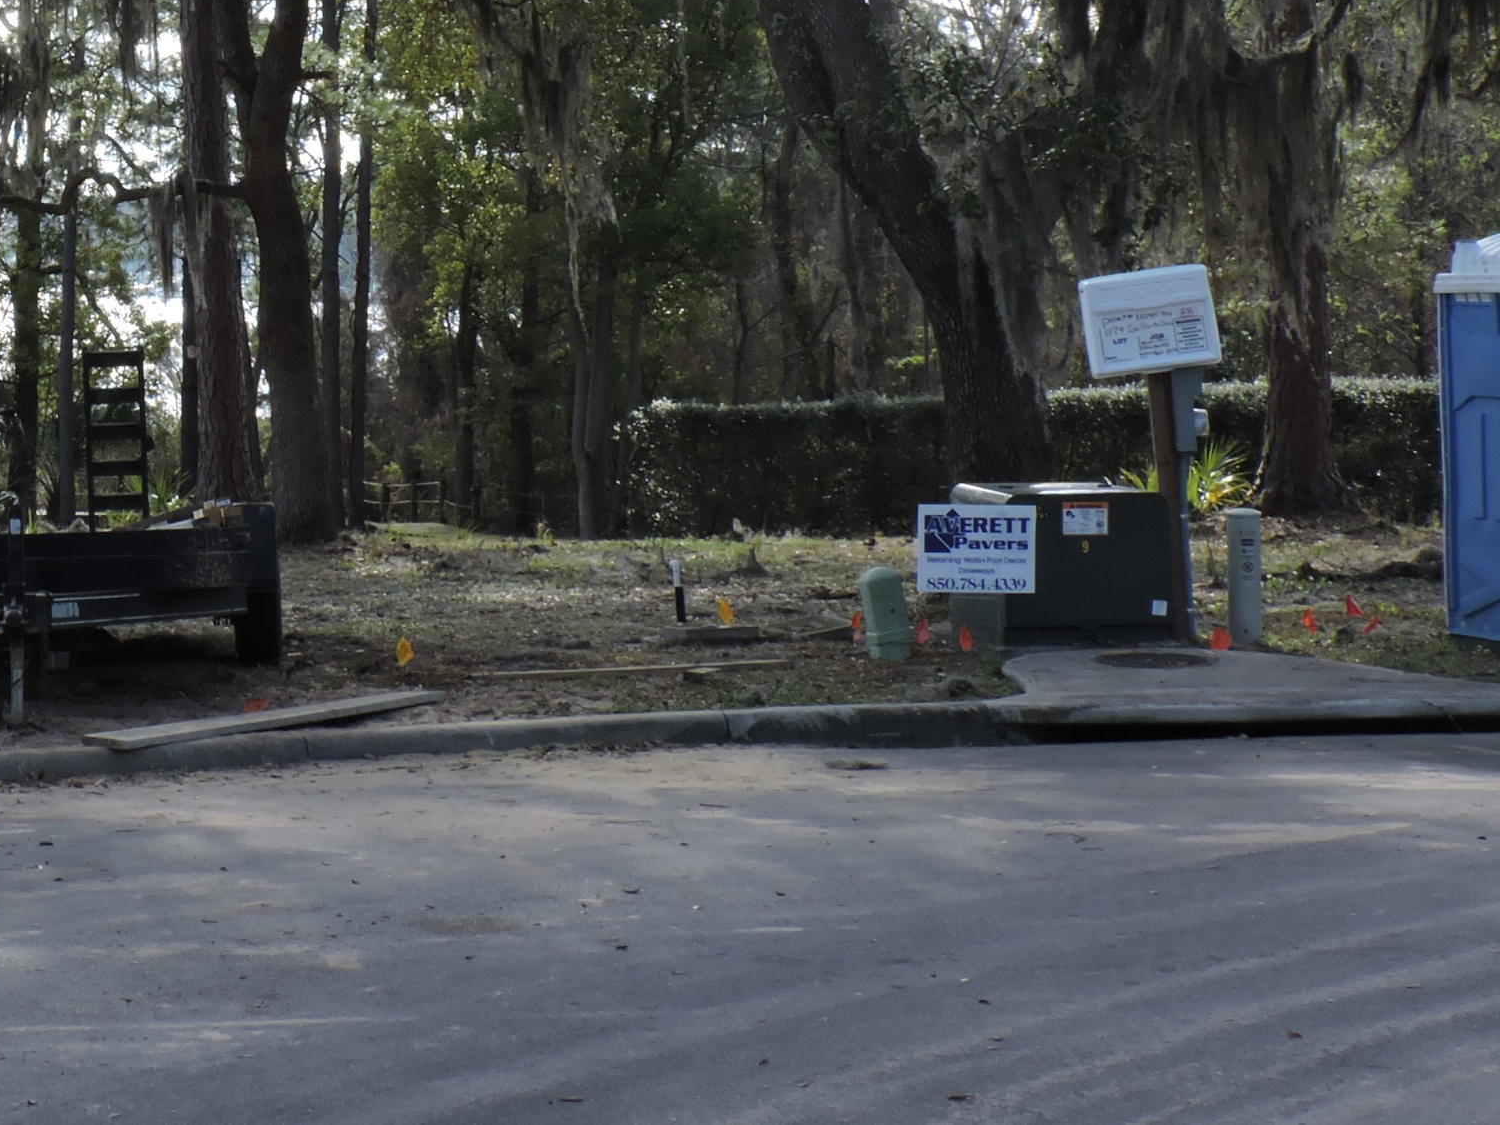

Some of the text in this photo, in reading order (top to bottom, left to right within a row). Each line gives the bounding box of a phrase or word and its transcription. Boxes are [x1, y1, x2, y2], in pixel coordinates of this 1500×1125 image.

[1112, 337, 1128, 345] LOT
[927, 515, 1031, 534] AVERETT
[954, 536, 1029, 550] Pavers
[926, 578, 1027, 591] 850.784.4339
